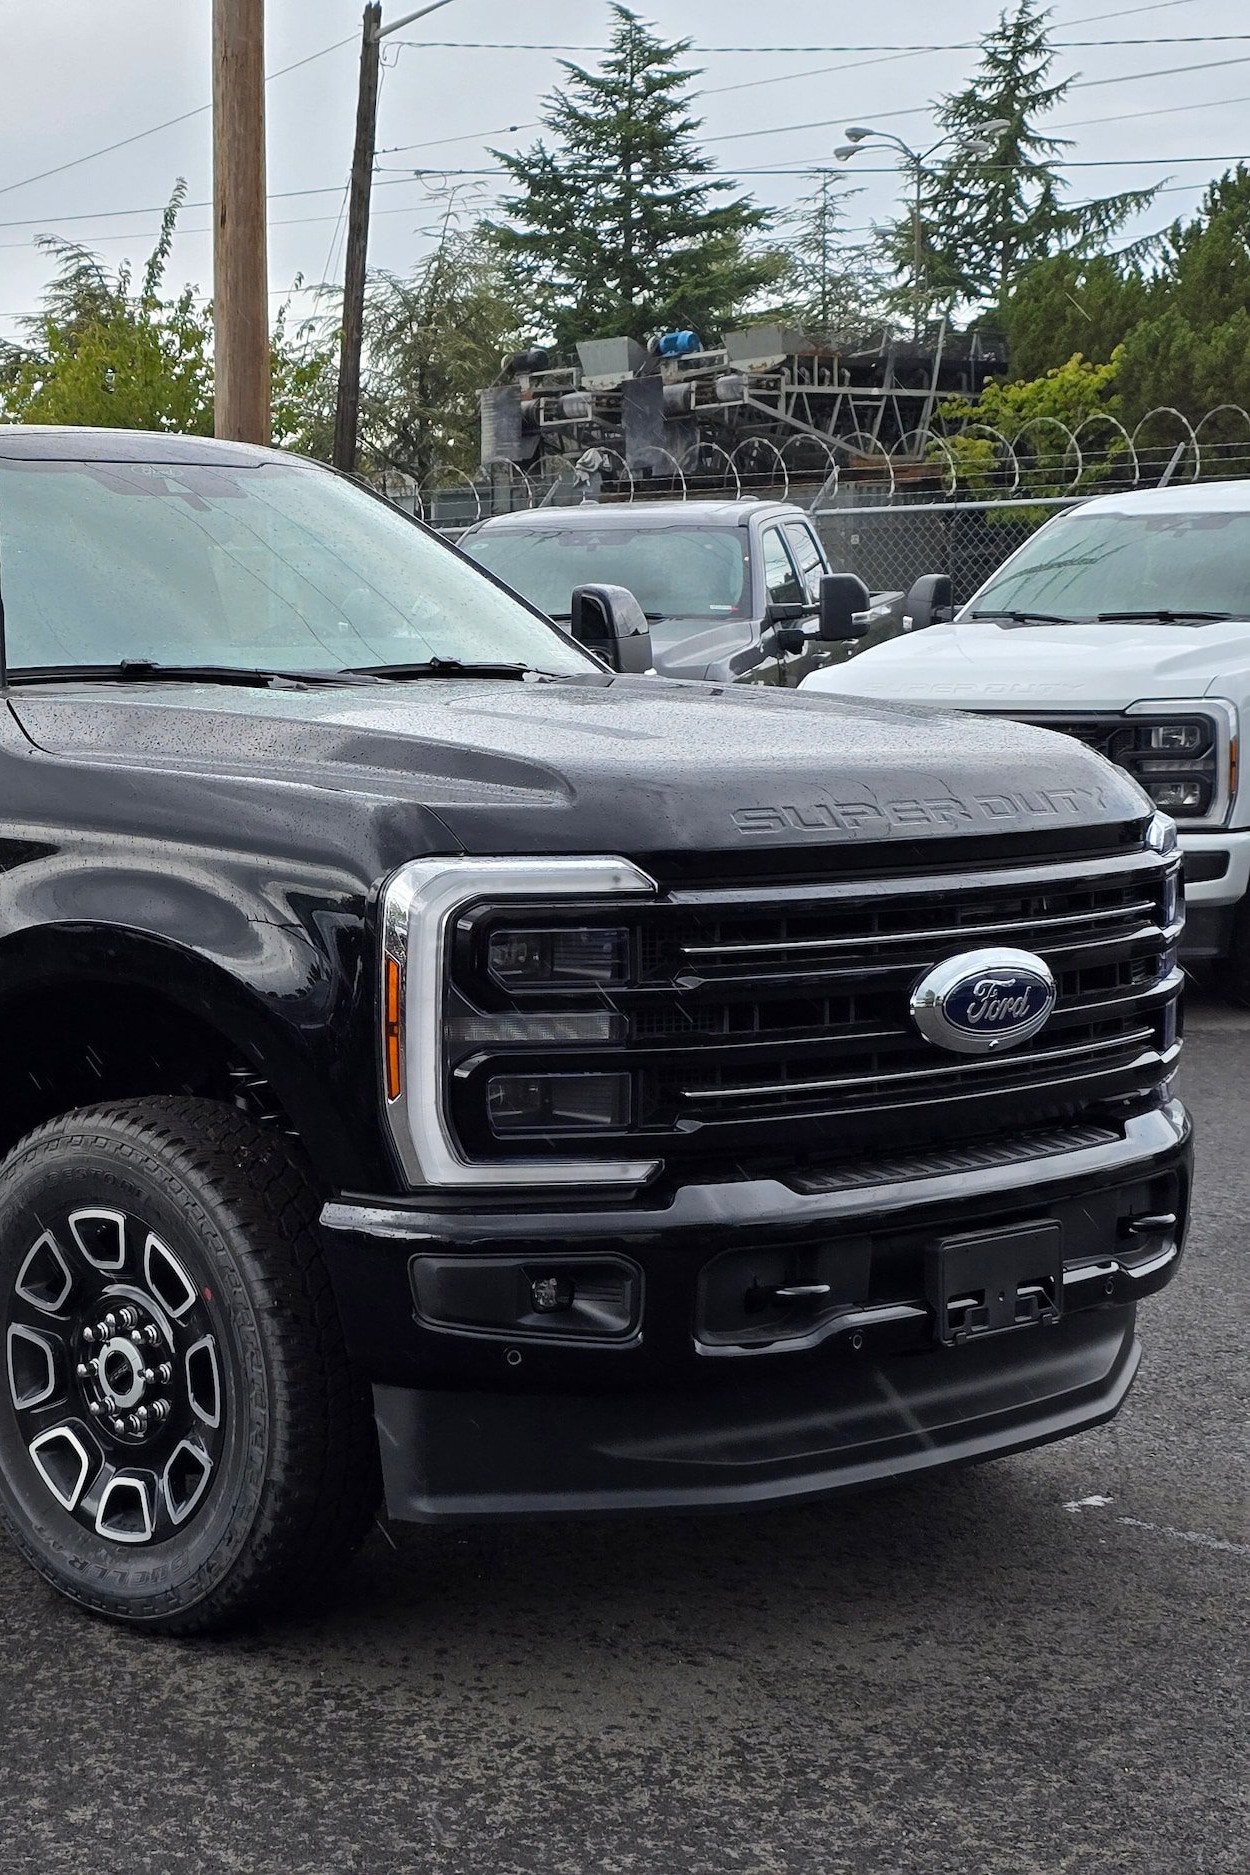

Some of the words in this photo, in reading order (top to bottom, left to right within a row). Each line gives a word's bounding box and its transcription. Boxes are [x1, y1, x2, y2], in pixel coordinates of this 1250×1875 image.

[980, 680, 1086, 695] DUTY
[729, 798, 973, 836] SUPER
[974, 787, 1108, 822] DUTY
[966, 978, 1032, 1024] Ford
